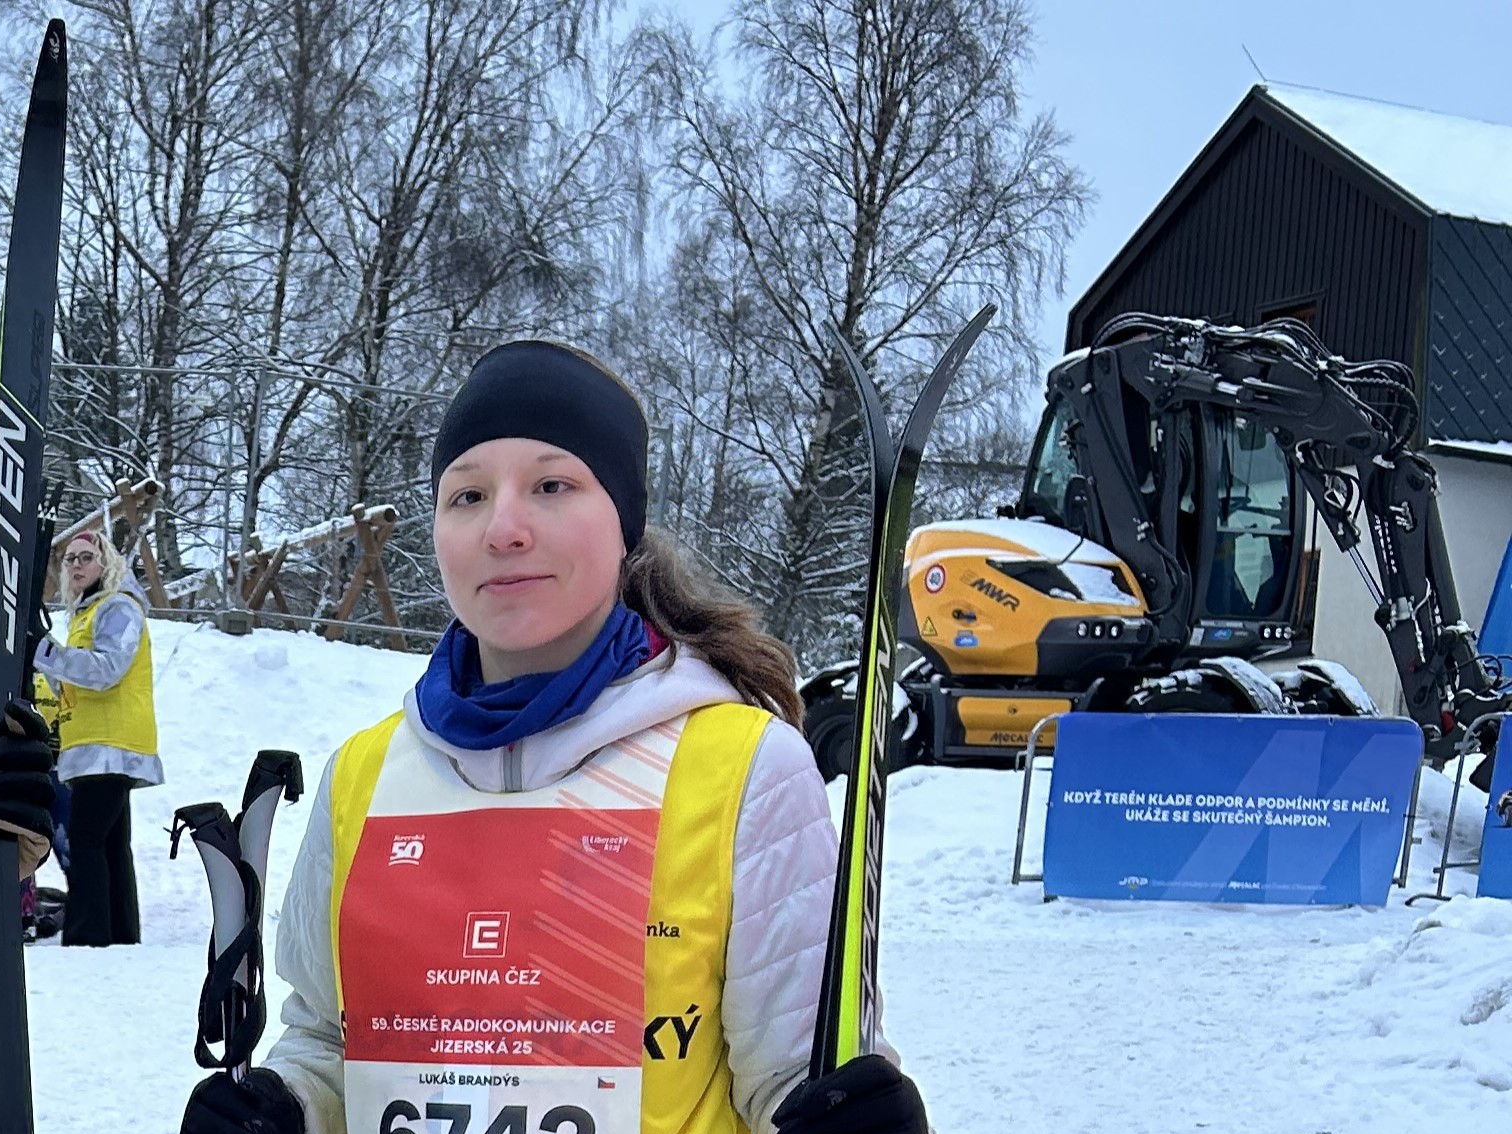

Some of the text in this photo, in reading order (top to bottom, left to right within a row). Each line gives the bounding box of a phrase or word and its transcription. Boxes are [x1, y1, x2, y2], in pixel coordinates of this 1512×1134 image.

[1064, 789, 1102, 805] KDYŽ
[1105, 790, 1146, 805] TERÉN
[1148, 792, 1193, 807] KLADE
[1195, 794, 1244, 808] ODPOR
[1245, 797, 1256, 809] A
[1257, 794, 1330, 811] PODMÍNKY
[1332, 799, 1349, 812] SE
[1125, 806, 1169, 822] UKÁŽE
[1172, 810, 1189, 823] SE
[1192, 809, 1263, 826] SKUTEČNÝ
[390, 840, 424, 861] 50
[426, 968, 541, 986] SKUPINA ČEZ
[372, 1014, 616, 1035] 59. ČESKÉ RADIOKOMUNIKACE
[430, 1037, 533, 1054] JIZERSKÁ 25
[419, 1072, 520, 1087] LUKÁŠ BRANDÝS
